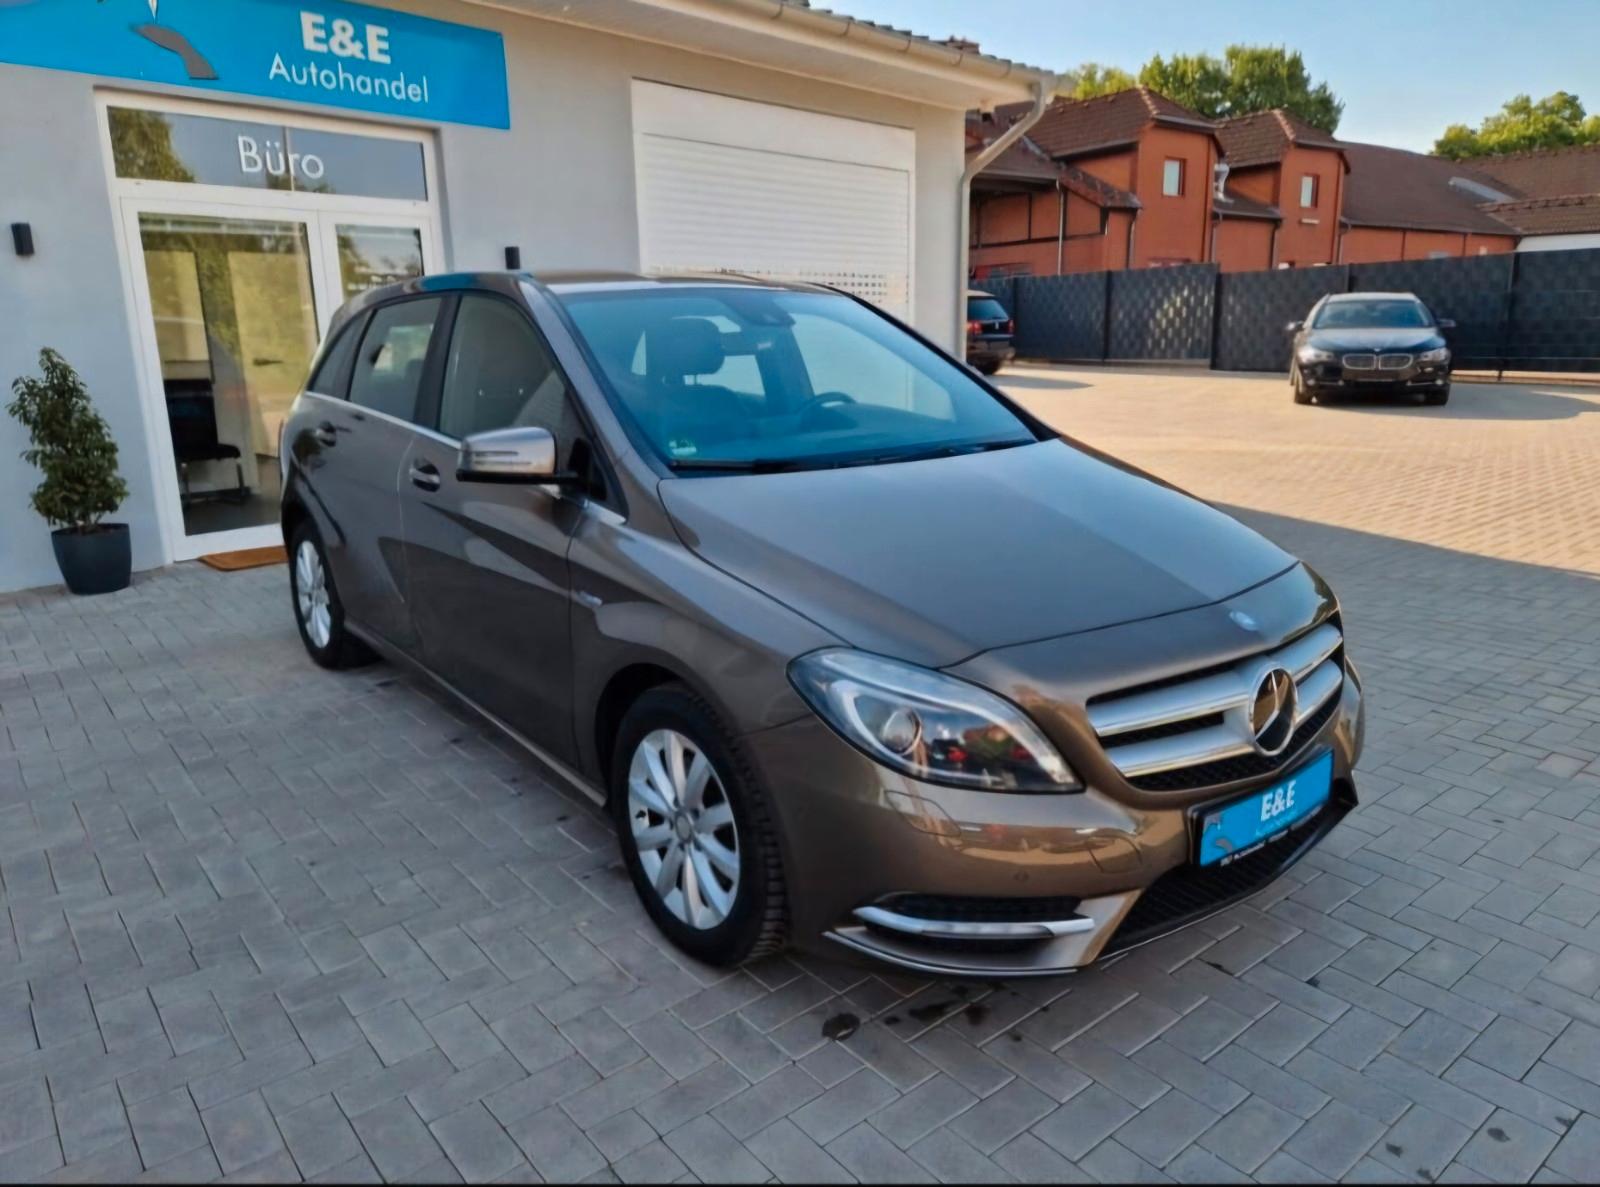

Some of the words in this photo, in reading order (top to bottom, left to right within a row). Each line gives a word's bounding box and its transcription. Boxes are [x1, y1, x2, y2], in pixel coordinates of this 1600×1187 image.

[301, 12, 391, 63] E&E
[270, 54, 429, 102] Autohandel
[238, 136, 324, 178] Büro
[1261, 780, 1296, 821] E&E
